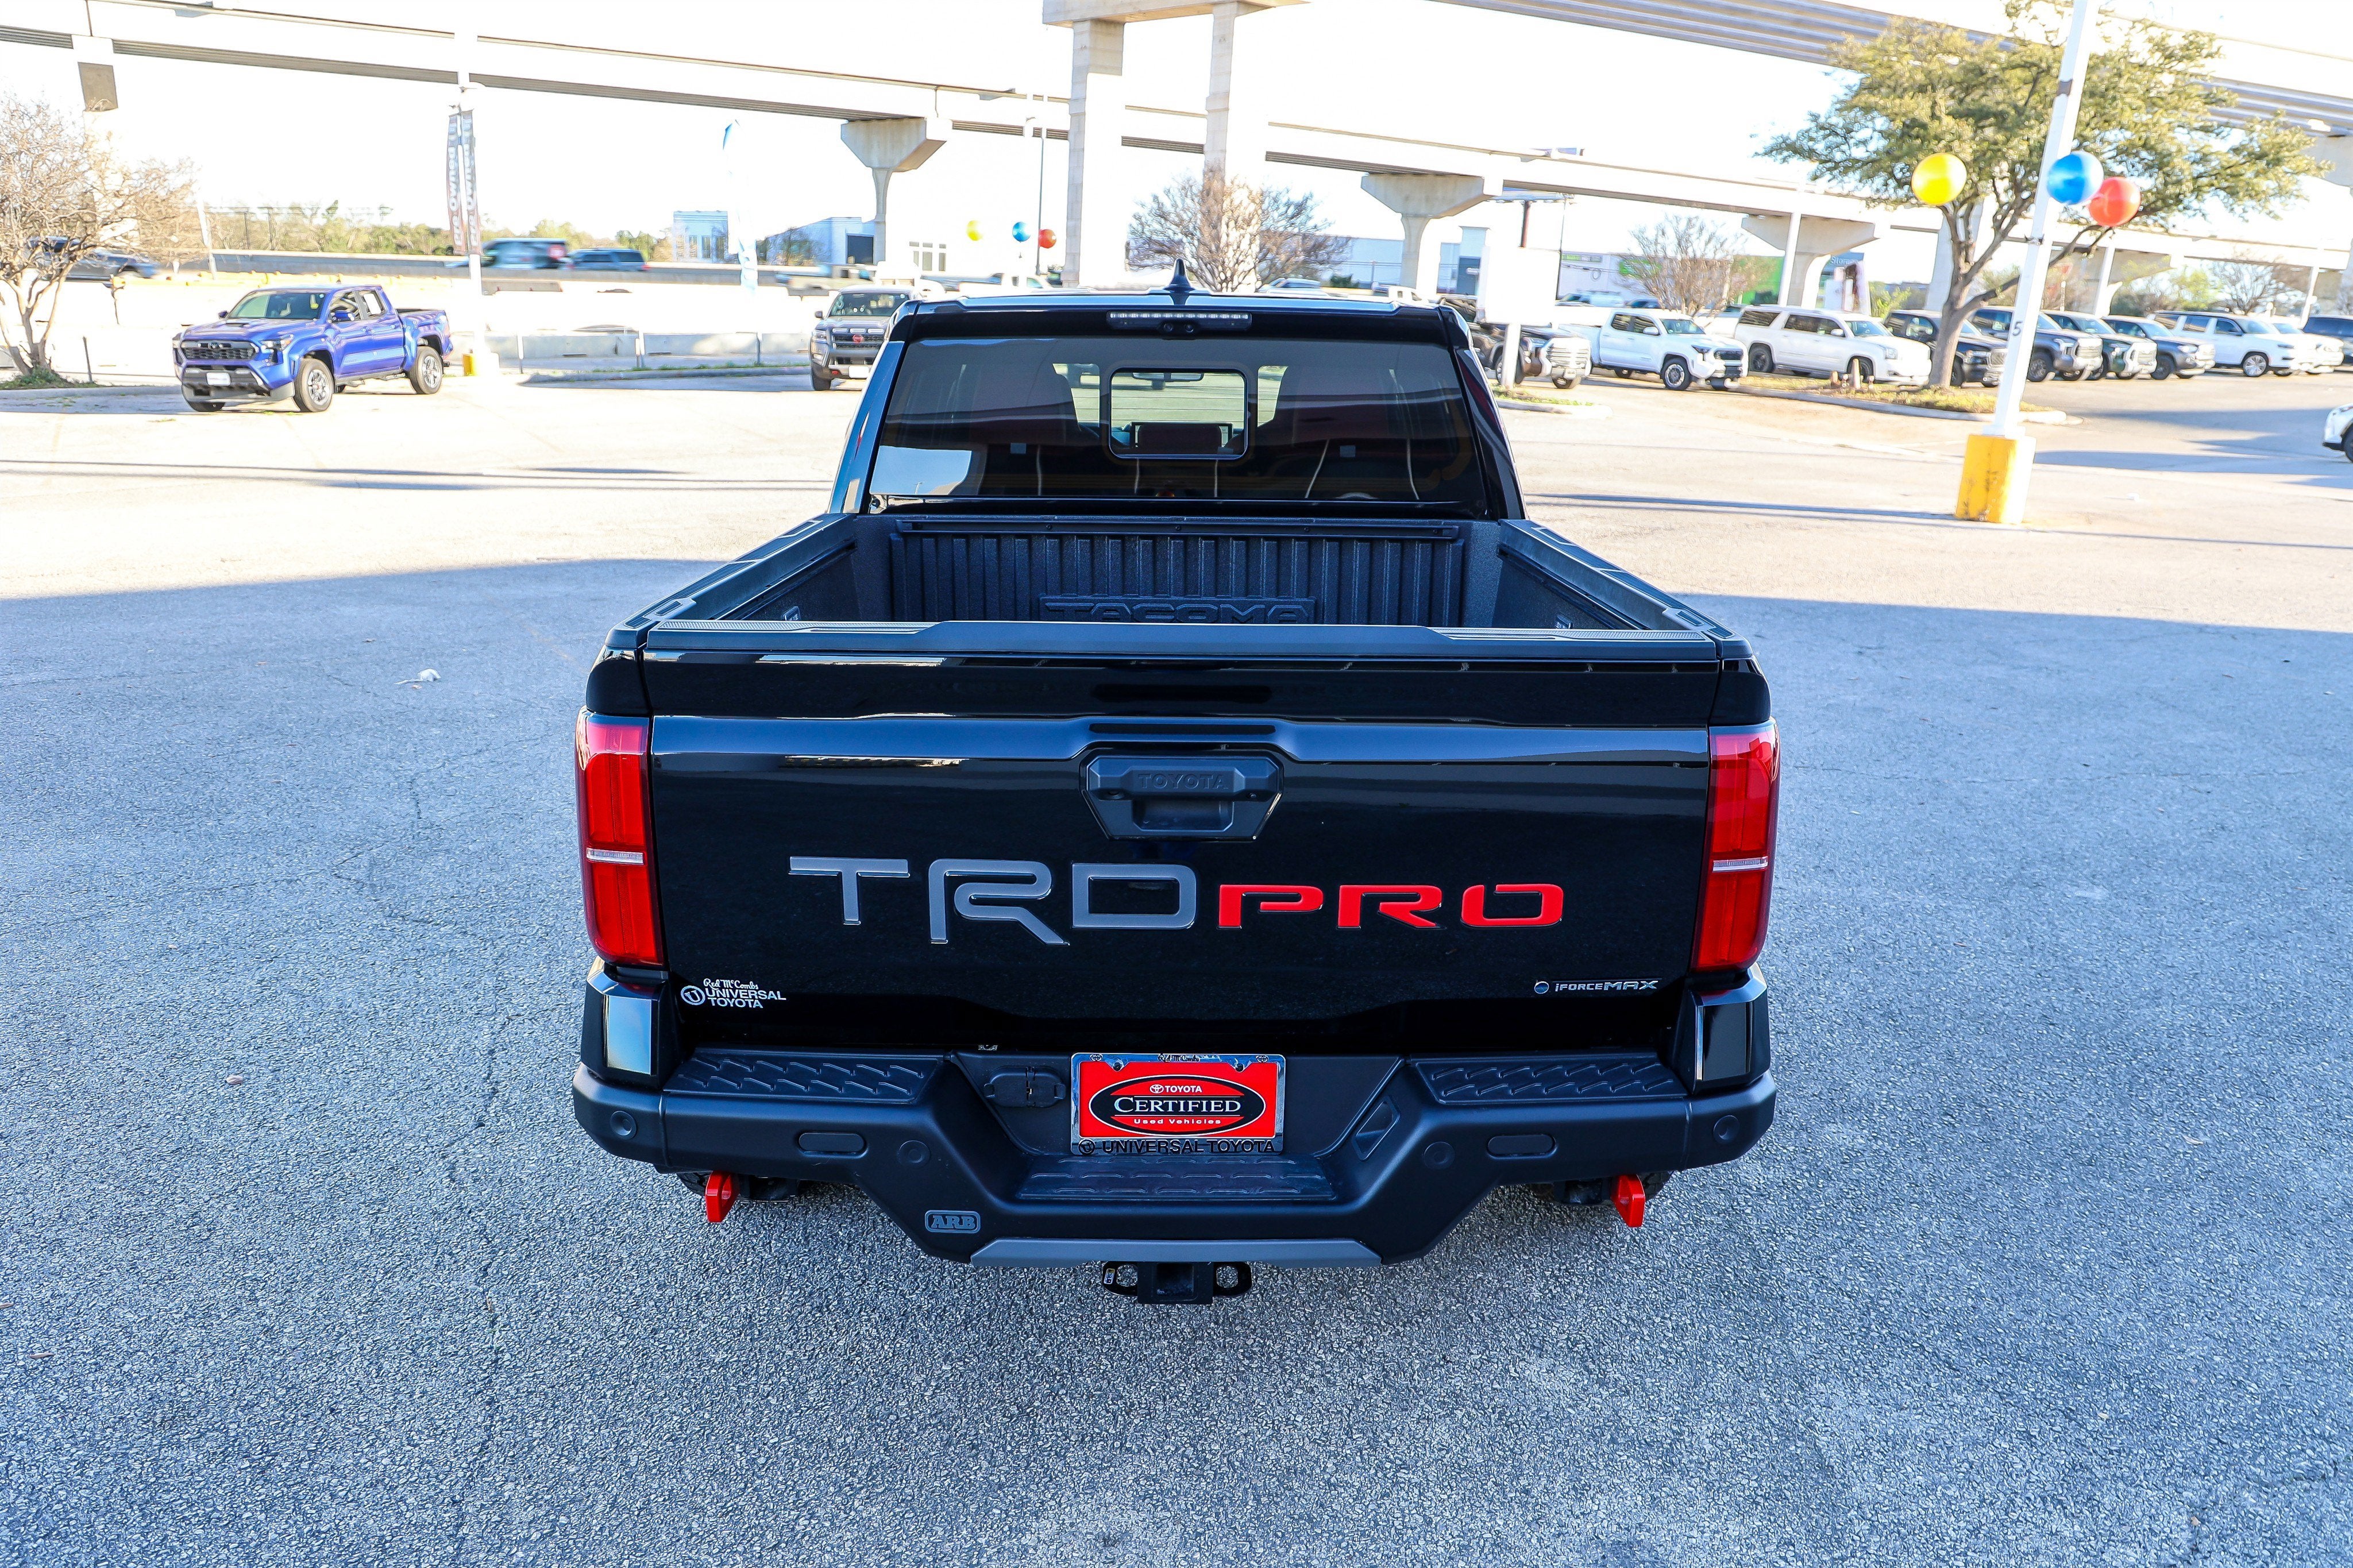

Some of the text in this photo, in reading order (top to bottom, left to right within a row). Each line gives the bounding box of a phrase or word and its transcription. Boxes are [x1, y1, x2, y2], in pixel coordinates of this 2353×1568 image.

[2012, 321, 2023, 336] 5
[1045, 603, 1308, 624] TACOMA
[1137, 773, 1229, 789] TOYOTA
[788, 856, 1197, 946] TRD
[1217, 883, 1564, 930] PRO
[703, 978, 758, 990] Red McCombs
[705, 988, 786, 1001] UNIVERSAL
[707, 997, 763, 1009] TOYOTA
[1165, 1085, 1202, 1093] TOYOTA
[1114, 1097, 1241, 1113] CERTIFIED
[1102, 1140, 1275, 1153] UNIVERSAL TOYOTA
[931, 1215, 975, 1229] ARB
